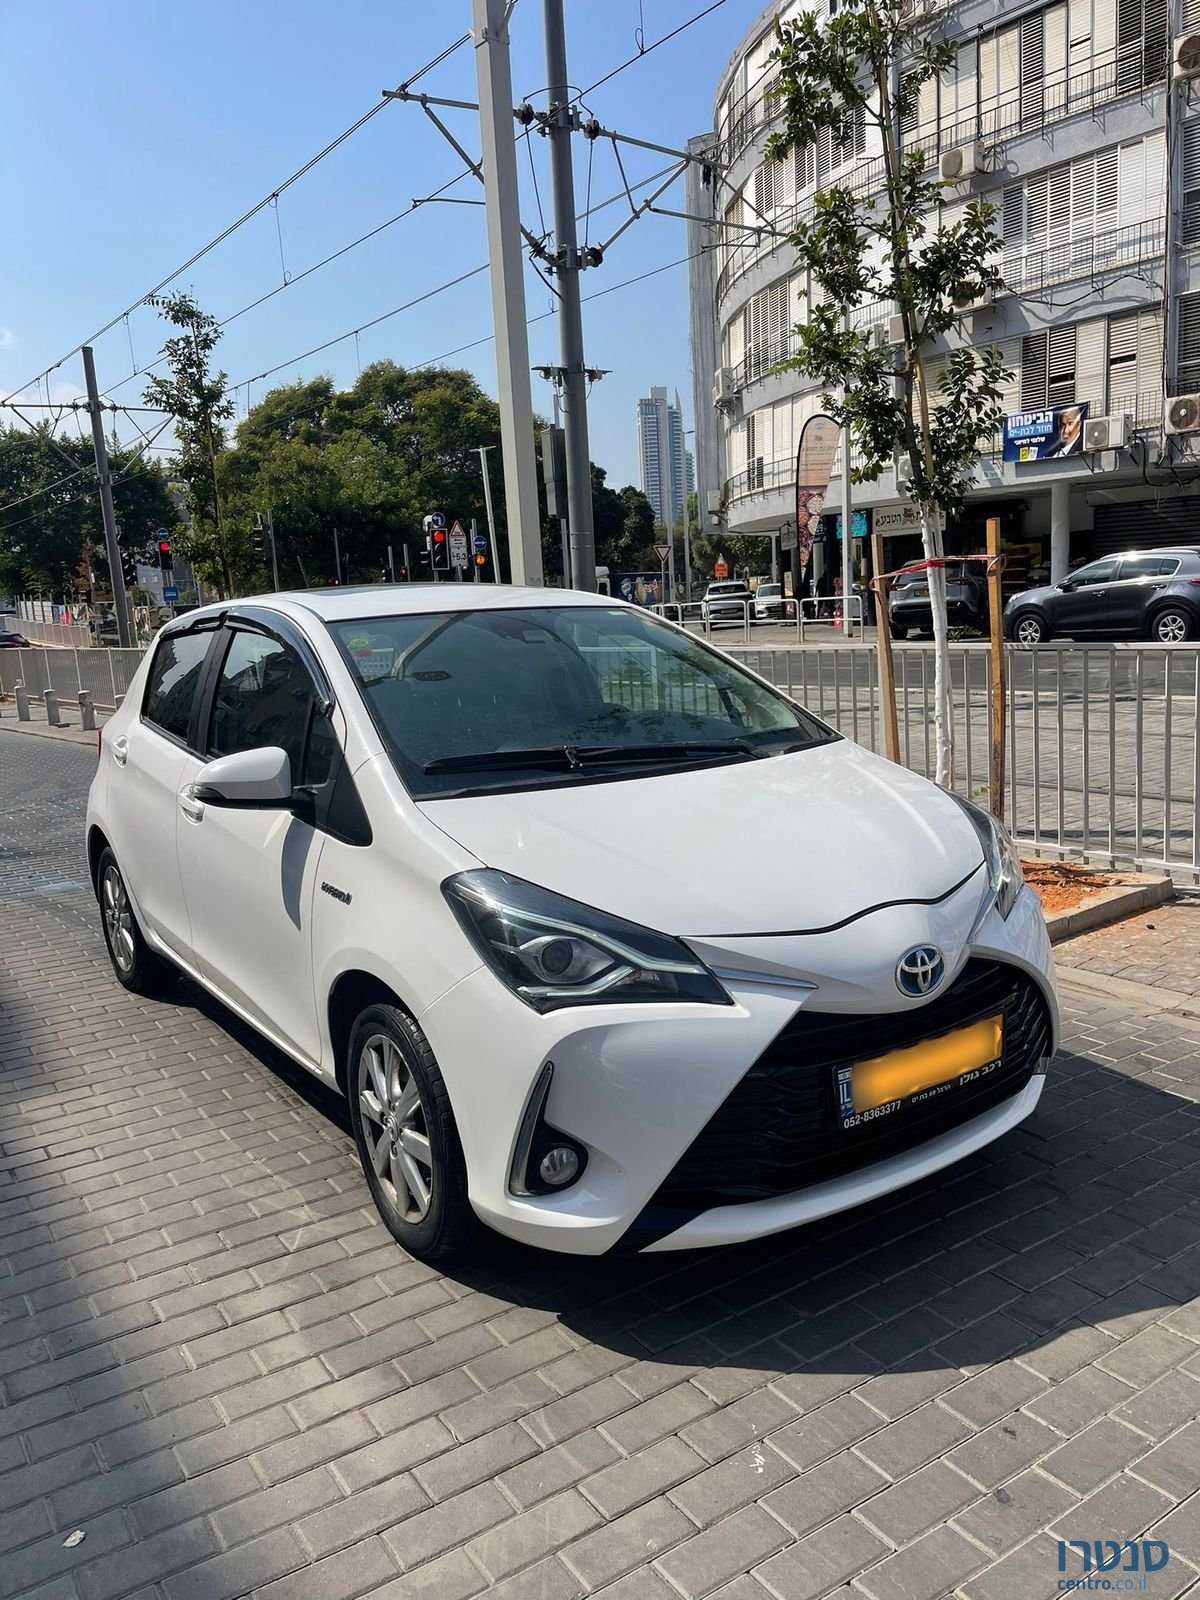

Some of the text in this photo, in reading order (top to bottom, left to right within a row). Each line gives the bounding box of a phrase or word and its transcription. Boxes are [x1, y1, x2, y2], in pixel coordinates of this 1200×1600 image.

[1007, 410, 1054, 430] הביטחון
[1009, 424, 1052, 437] חוזר לבת-ים
[880, 513, 902, 526] הטבע
[959, 1060, 1001, 1086] רכב גולן
[839, 1083, 852, 1104] IL
[911, 1095, 919, 1103] ים
[919, 1092, 928, 1100] בת
[843, 1099, 902, 1129] 052-8363377
